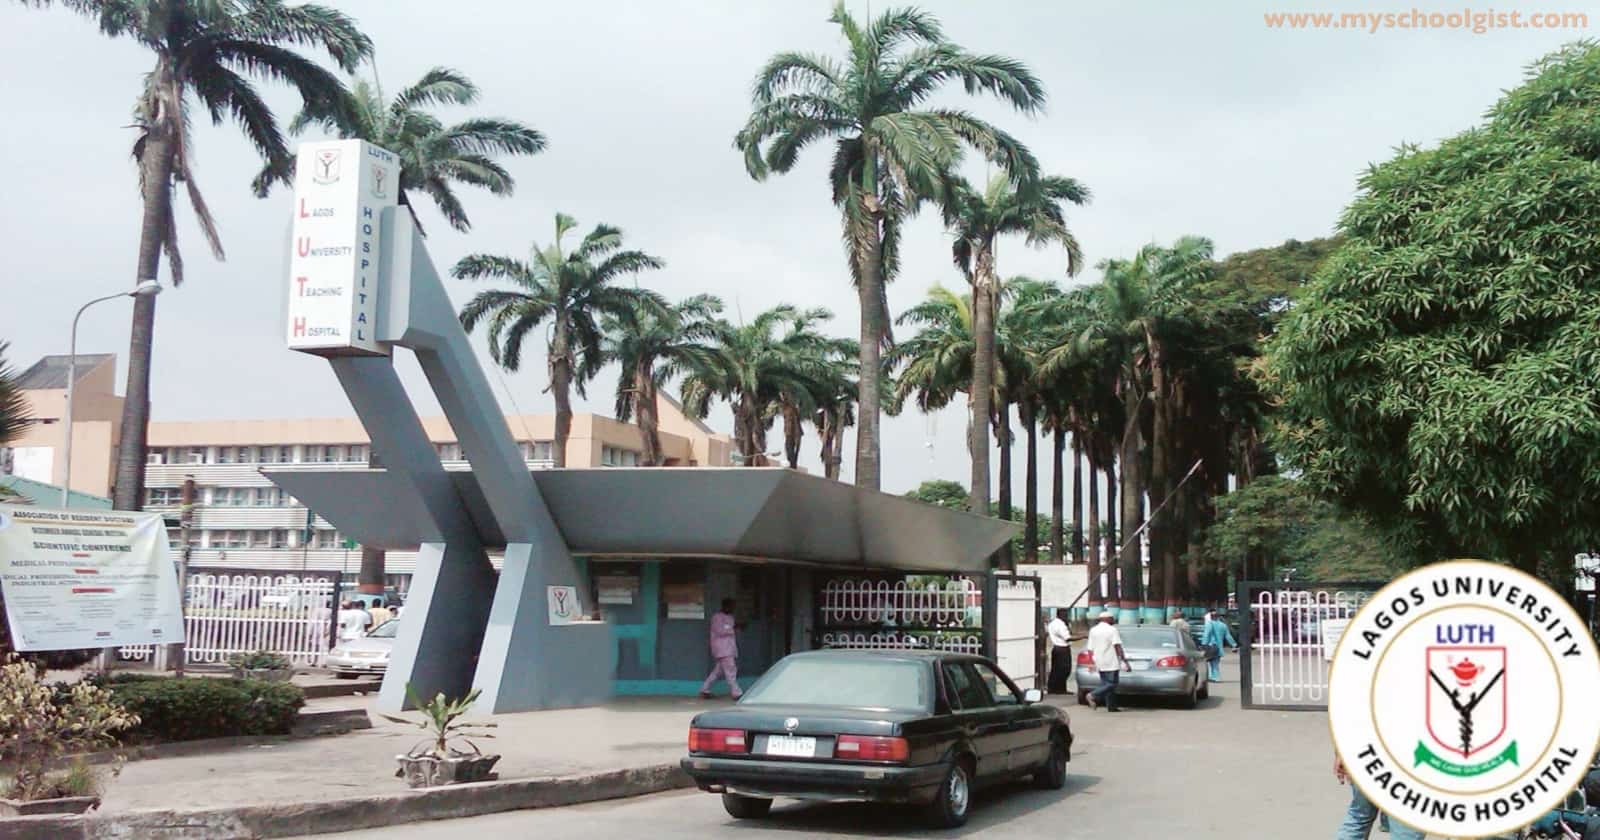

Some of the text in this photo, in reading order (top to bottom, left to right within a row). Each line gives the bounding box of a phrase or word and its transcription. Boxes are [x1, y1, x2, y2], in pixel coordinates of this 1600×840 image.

[368, 145, 393, 162] LUTH
[357, 207, 372, 341] HOSPITAL
[33, 541, 132, 553] SCIENTIFIC CONFERENCE
